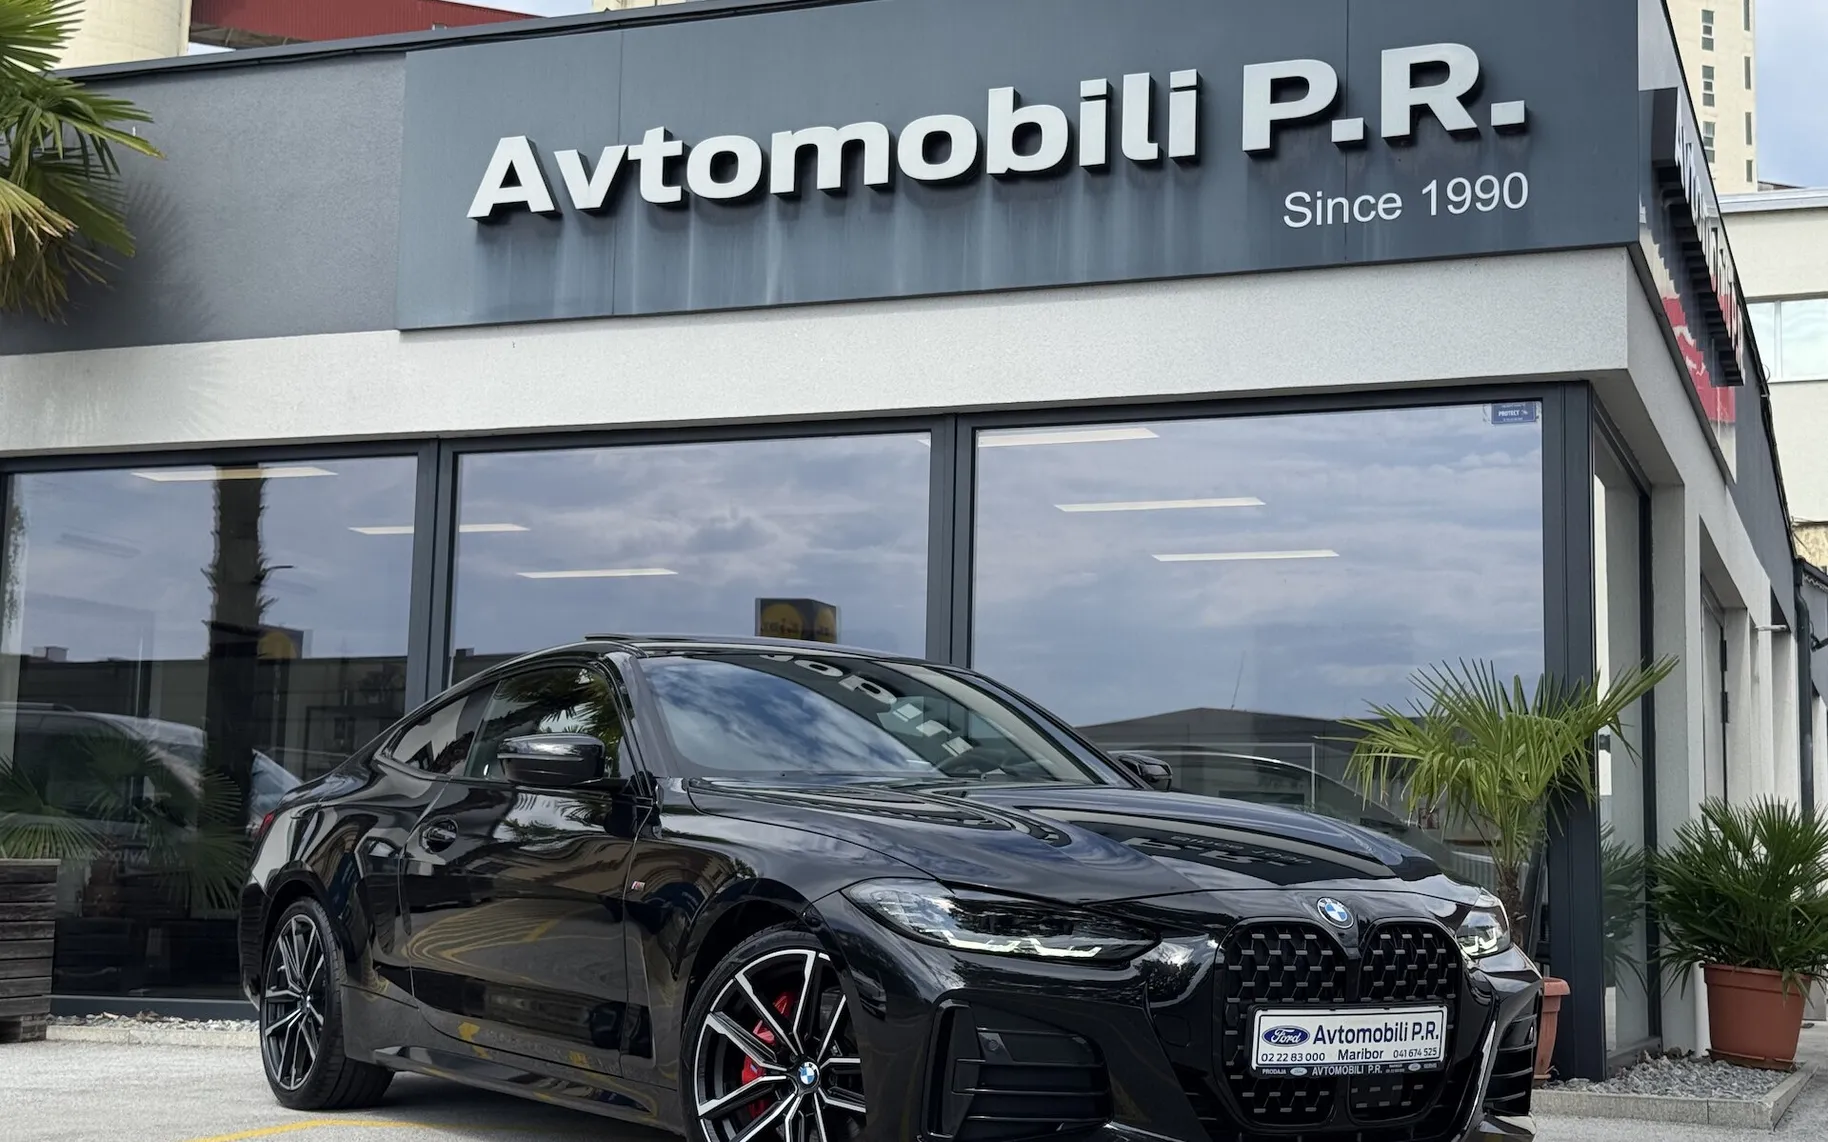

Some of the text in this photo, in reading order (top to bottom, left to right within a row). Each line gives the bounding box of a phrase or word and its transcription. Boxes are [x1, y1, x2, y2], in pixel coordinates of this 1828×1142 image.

[466, 42, 1527, 220] Avtomobili P.R.
[1283, 171, 1530, 228] Since 1990
[1270, 1028, 1302, 1044] Ford
[1313, 1021, 1439, 1045] Avtomobili P.R.
[1261, 1052, 1326, 1062] 02 22 83 000
[1337, 1048, 1384, 1061] Maribor
[1423, 1047, 1437, 1057] 525
[1312, 1065, 1364, 1076] AVTOMOBILI
[1367, 1064, 1383, 1074] P.R.
